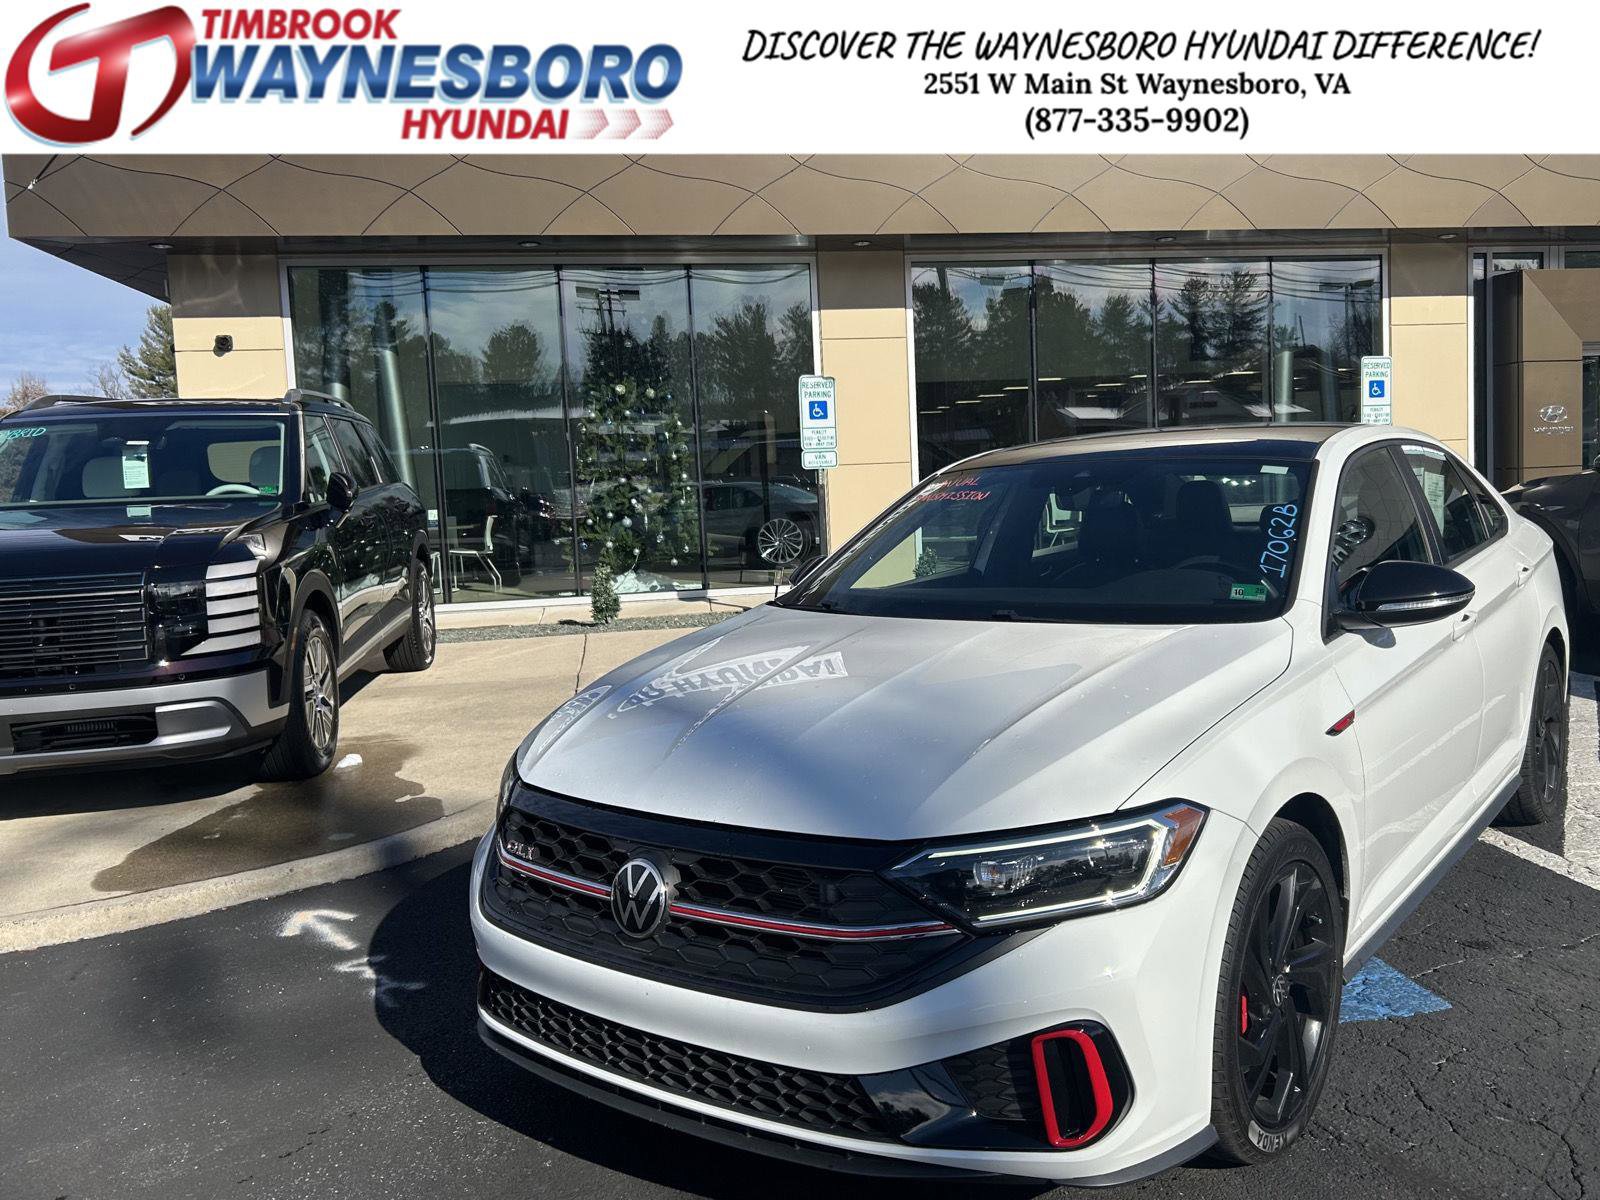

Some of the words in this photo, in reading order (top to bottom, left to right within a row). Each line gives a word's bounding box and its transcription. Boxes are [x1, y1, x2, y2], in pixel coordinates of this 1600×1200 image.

[801, 381, 832, 389] RESERVED
[1260, 504, 1298, 578] 17062B
[1256, 1129, 1288, 1153] KENDA
